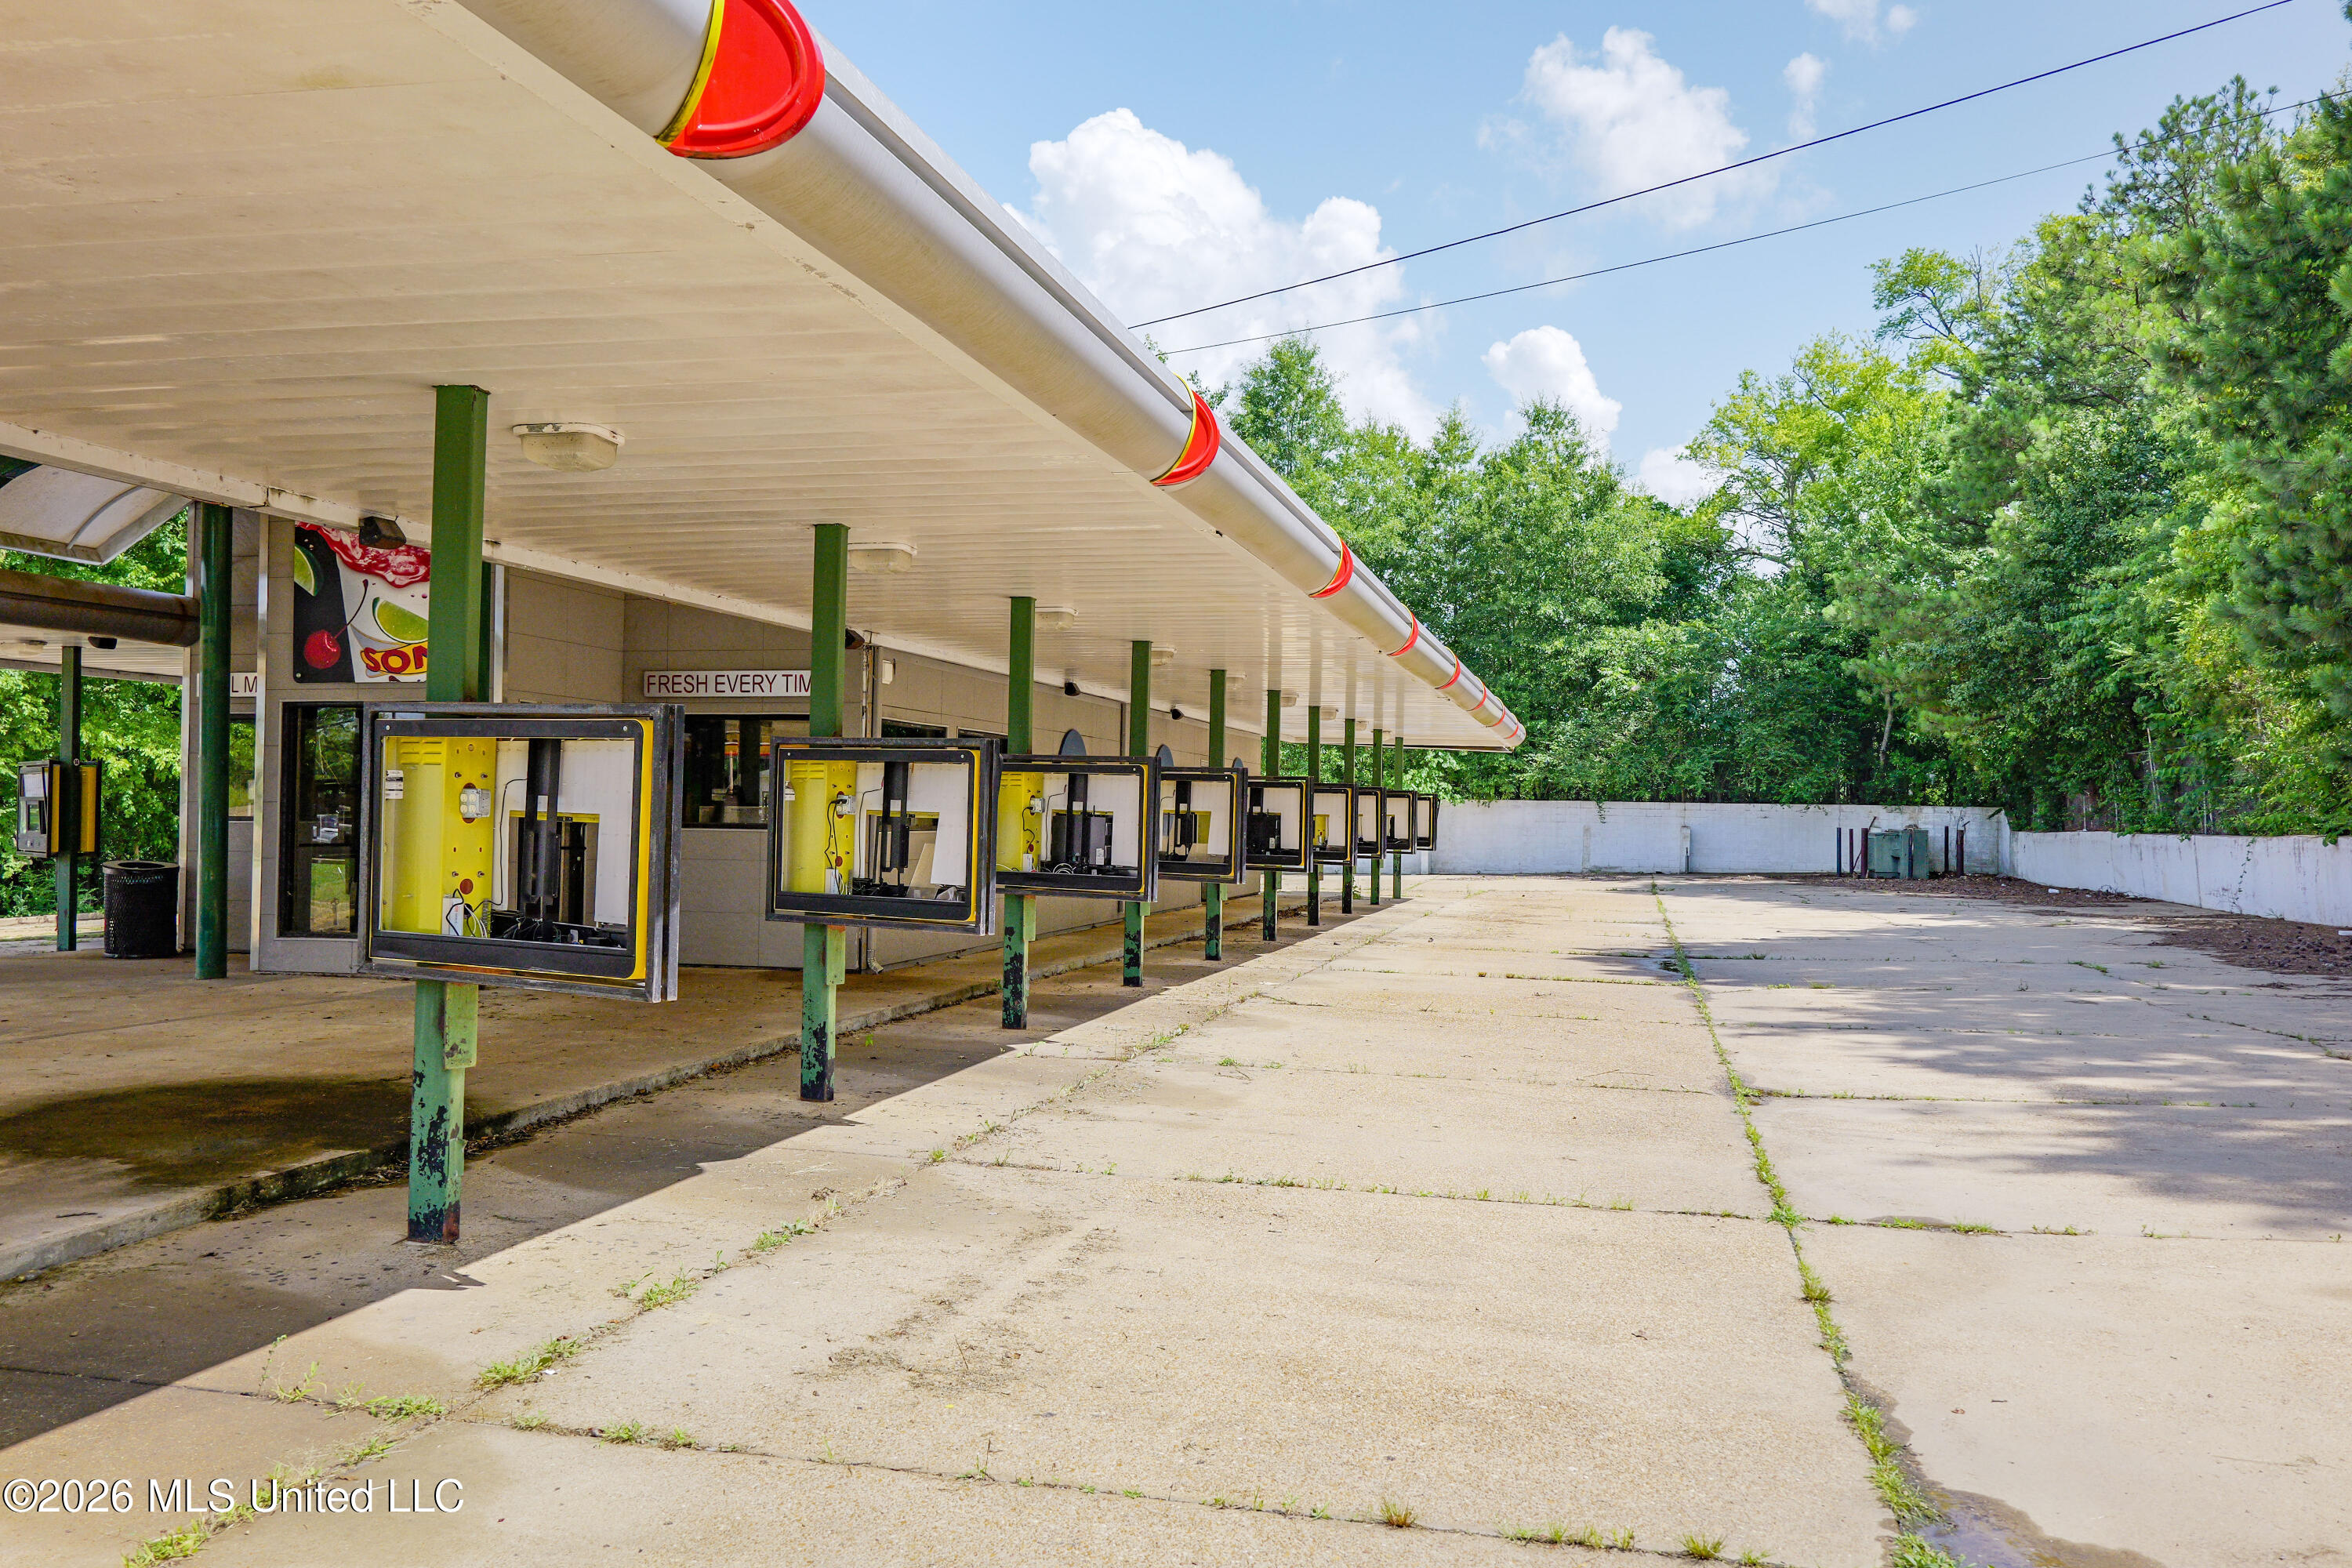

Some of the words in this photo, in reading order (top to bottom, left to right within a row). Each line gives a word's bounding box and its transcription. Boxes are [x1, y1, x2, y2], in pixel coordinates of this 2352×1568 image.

[647, 674, 707, 693] FRESH
[715, 674, 777, 693] EVERY
[782, 674, 811, 693] TIM
